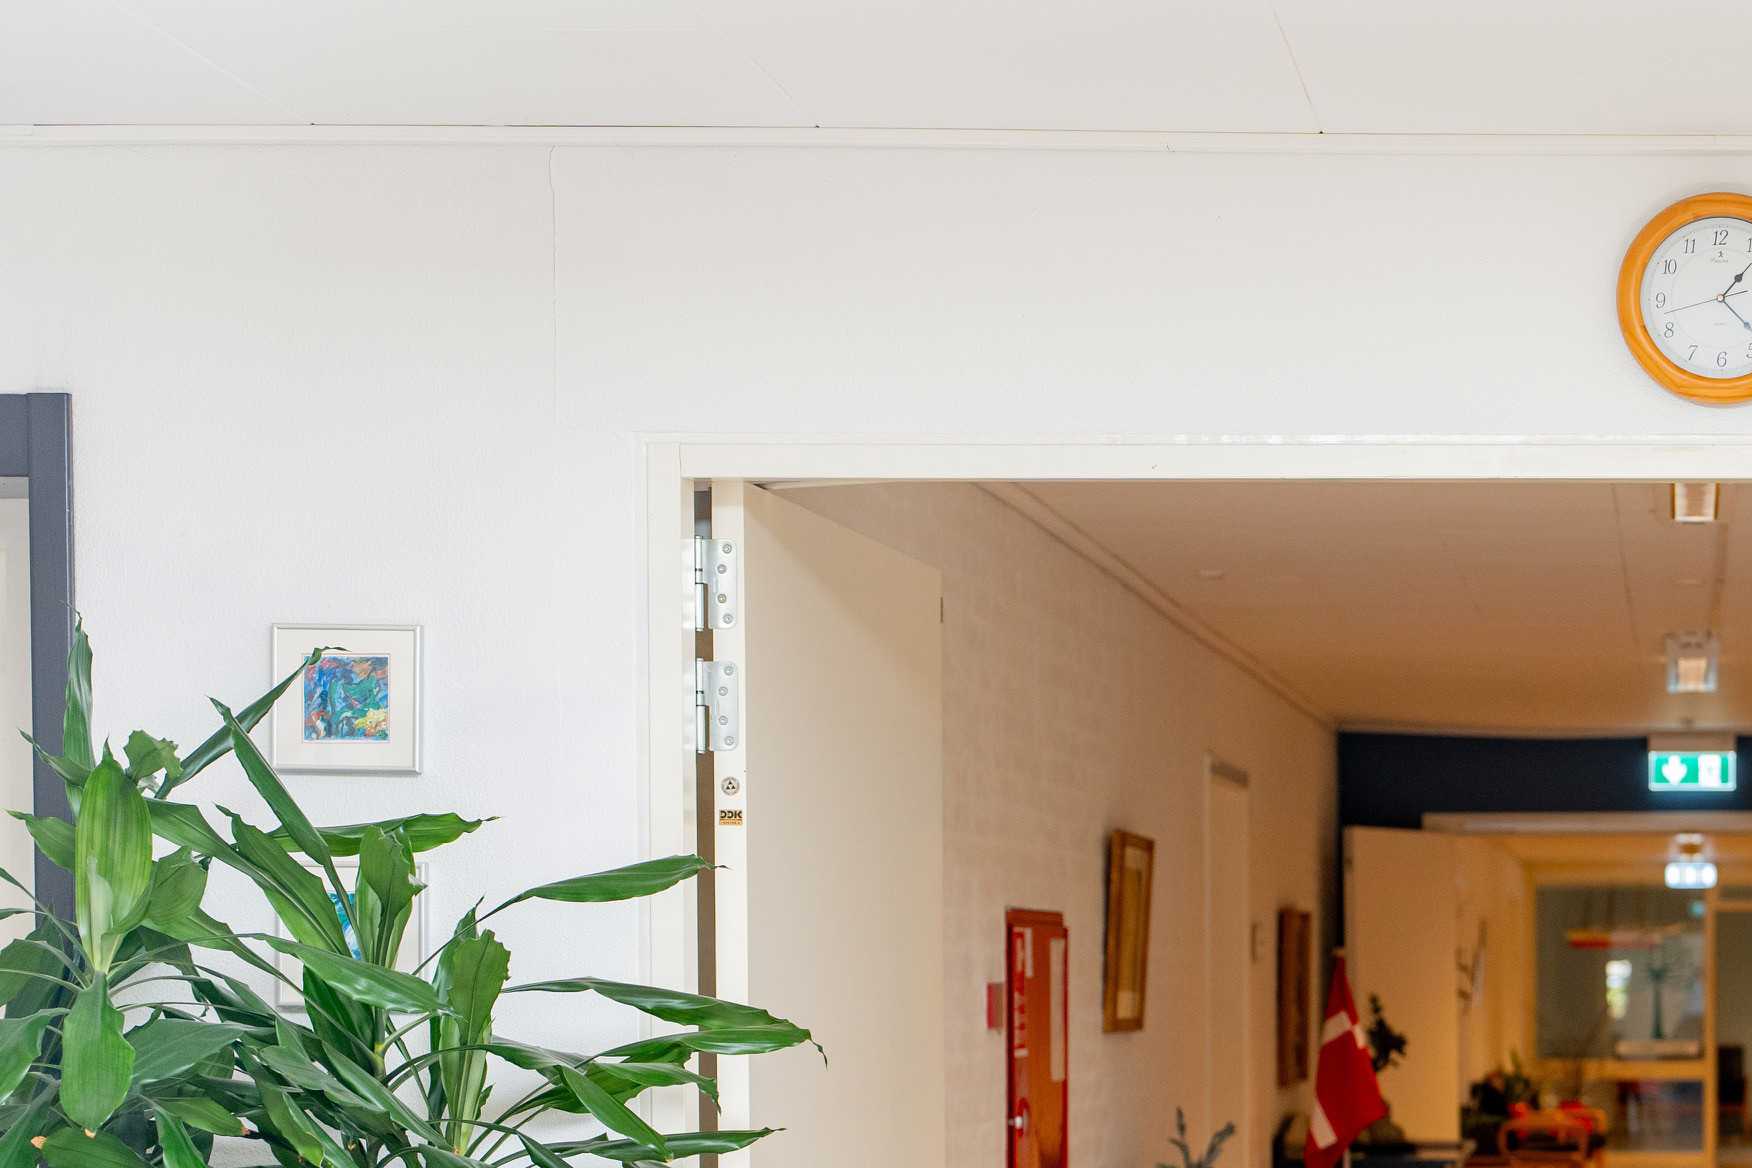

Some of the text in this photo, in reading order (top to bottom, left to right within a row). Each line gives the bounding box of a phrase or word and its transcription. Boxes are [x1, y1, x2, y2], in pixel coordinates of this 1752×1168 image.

[1711, 229, 1729, 246] 12
[1746, 237, 1752, 253] 1
[1683, 238, 1697, 254] 11
[1663, 259, 1678, 275] 10
[1655, 292, 1666, 309] 9
[1663, 322, 1674, 339] 8
[1688, 345, 1698, 361] 7
[1716, 351, 1728, 368] 6
